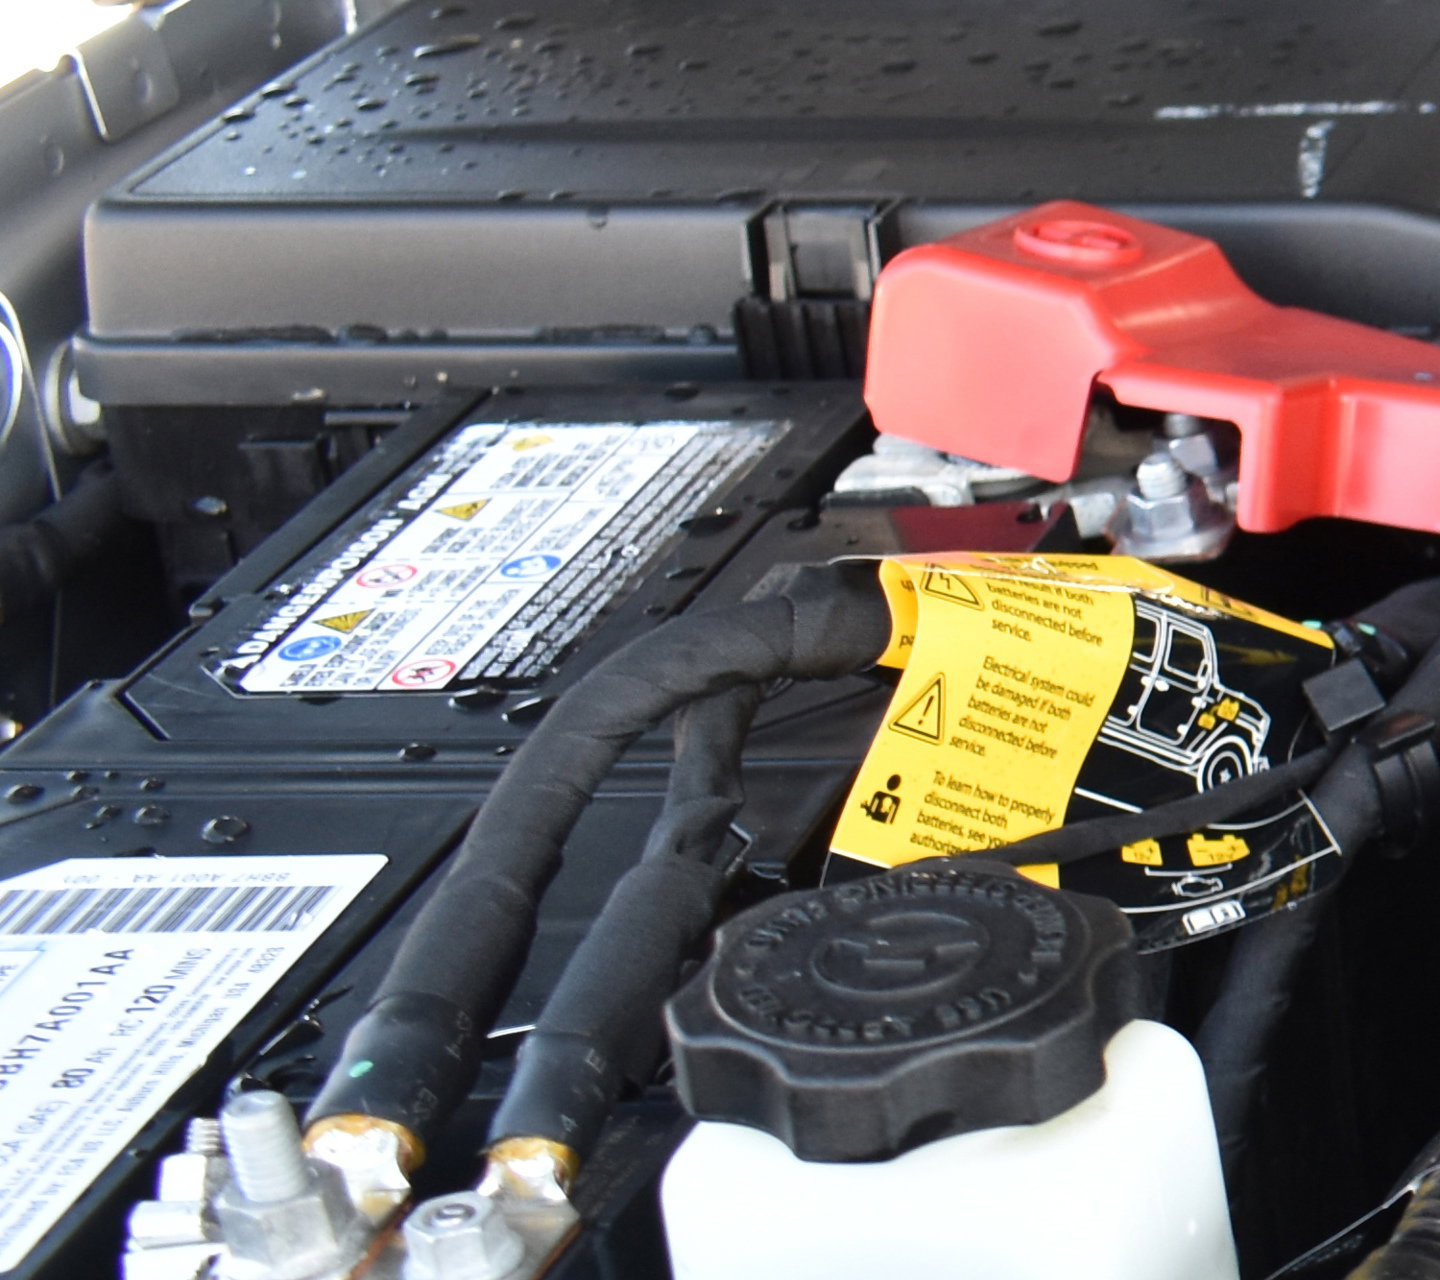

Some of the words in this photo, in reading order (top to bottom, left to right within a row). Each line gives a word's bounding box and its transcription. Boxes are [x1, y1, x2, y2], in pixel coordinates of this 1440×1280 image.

[987, 583, 1041, 606] batteries
[1042, 596, 1062, 611] are
[1062, 601, 1082, 619] not
[1064, 587, 1095, 606] both
[992, 600, 1068, 632] disconnected
[1068, 624, 1103, 647] before
[976, 676, 989, 691] be
[992, 681, 1038, 709] damaged
[1039, 694, 1049, 710] if
[1047, 699, 1072, 720] both
[983, 654, 1029, 681] Electrical
[1030, 669, 1065, 696] system
[1065, 685, 1095, 707] could
[968, 695, 1012, 720] batteries
[1011, 708, 1030, 726] are
[1030, 716, 1048, 733] not
[958, 716, 1024, 746] disconnected
[1025, 734, 1058, 759] before
[924, 793, 981, 820] disconnect
[982, 808, 1009, 829] both
[933, 769, 946, 785] To
[947, 774, 973, 795] learn
[974, 783, 996, 801] how
[997, 791, 1009, 805] to
[1009, 796, 1055, 825] properly
[967, 828, 986, 843] see
[51, 1067, 96, 1089] 80
[125, 984, 175, 1015] 120
